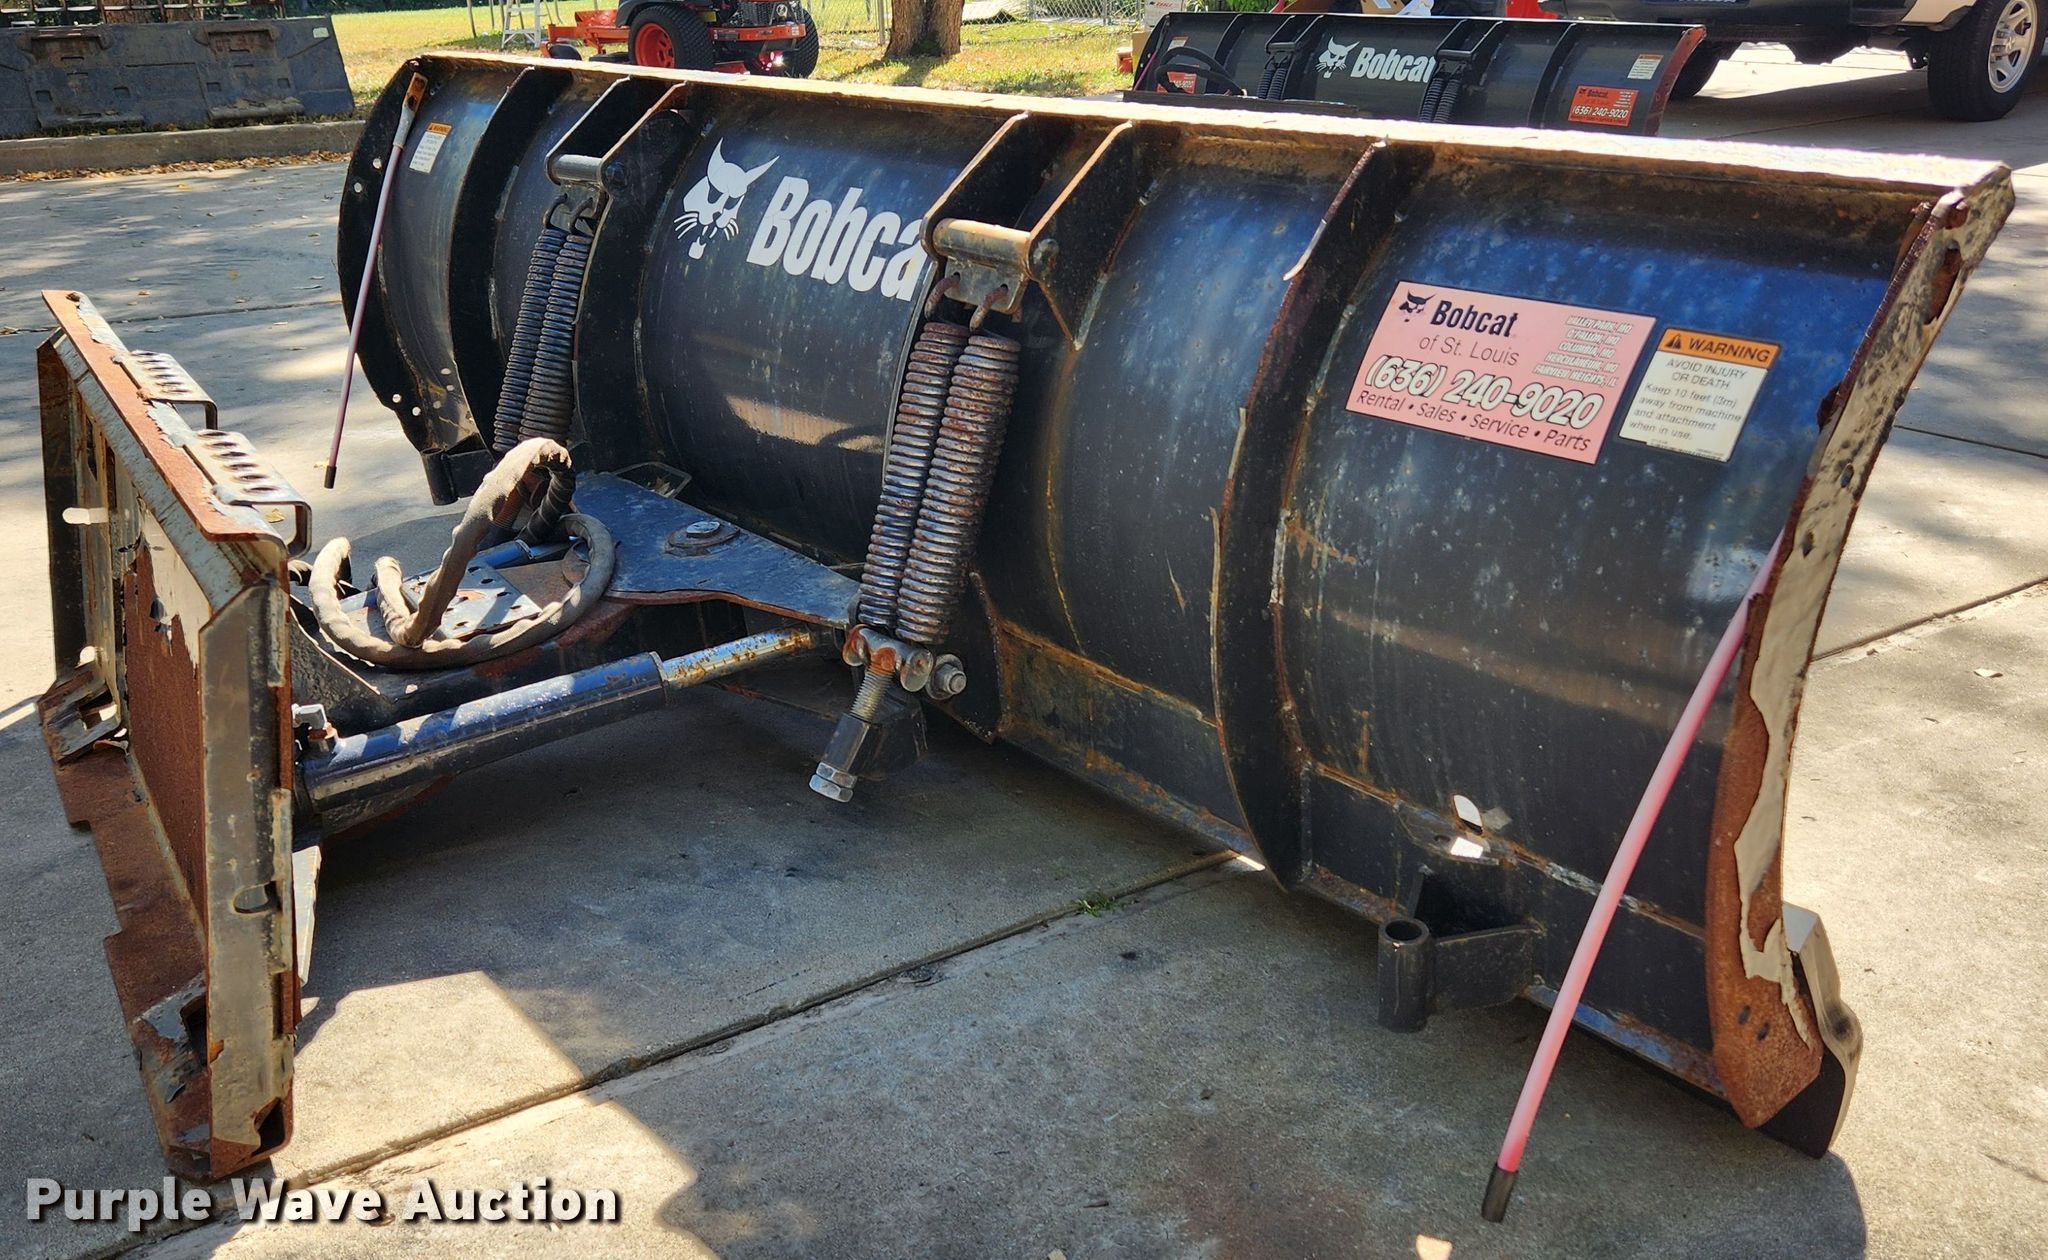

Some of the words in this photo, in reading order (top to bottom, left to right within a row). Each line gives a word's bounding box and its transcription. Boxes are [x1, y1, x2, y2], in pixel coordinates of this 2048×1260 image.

[1350, 47, 1437, 83] Bobcat
[1591, 107, 1629, 119] 240-9020
[746, 176, 929, 301] Bobca
[1430, 300, 1519, 338] Bobcat
[1419, 334, 1439, 351] of
[1440, 336, 1462, 356] St.
[1470, 341, 1520, 366] Louis
[1688, 337, 1771, 363] WARNING
[1665, 358, 1703, 372] AVOID
[1703, 363, 1748, 379] INJURY
[1672, 372, 1690, 382] OR
[1690, 375, 1731, 389] DEATH
[1364, 354, 1449, 398] (636)
[1441, 369, 1605, 430] 240-9020
[1645, 382, 1671, 396] Keep
[1675, 388, 1688, 398] 10
[1689, 391, 1711, 401] feet
[1357, 390, 1406, 412] Rental
[1416, 402, 1457, 423] Sales
[1469, 413, 1530, 438] Service
[1544, 429, 1591, 452] Parts
[1633, 408, 1654, 419] and
[1655, 411, 1717, 432] attachment
[1638, 397, 1666, 409] away
[1668, 399, 1693, 413] from
[1695, 407, 1742, 423] machine
[1629, 420, 1656, 432] when
[1659, 425, 1669, 435] in
[1671, 429, 1693, 441] use.
